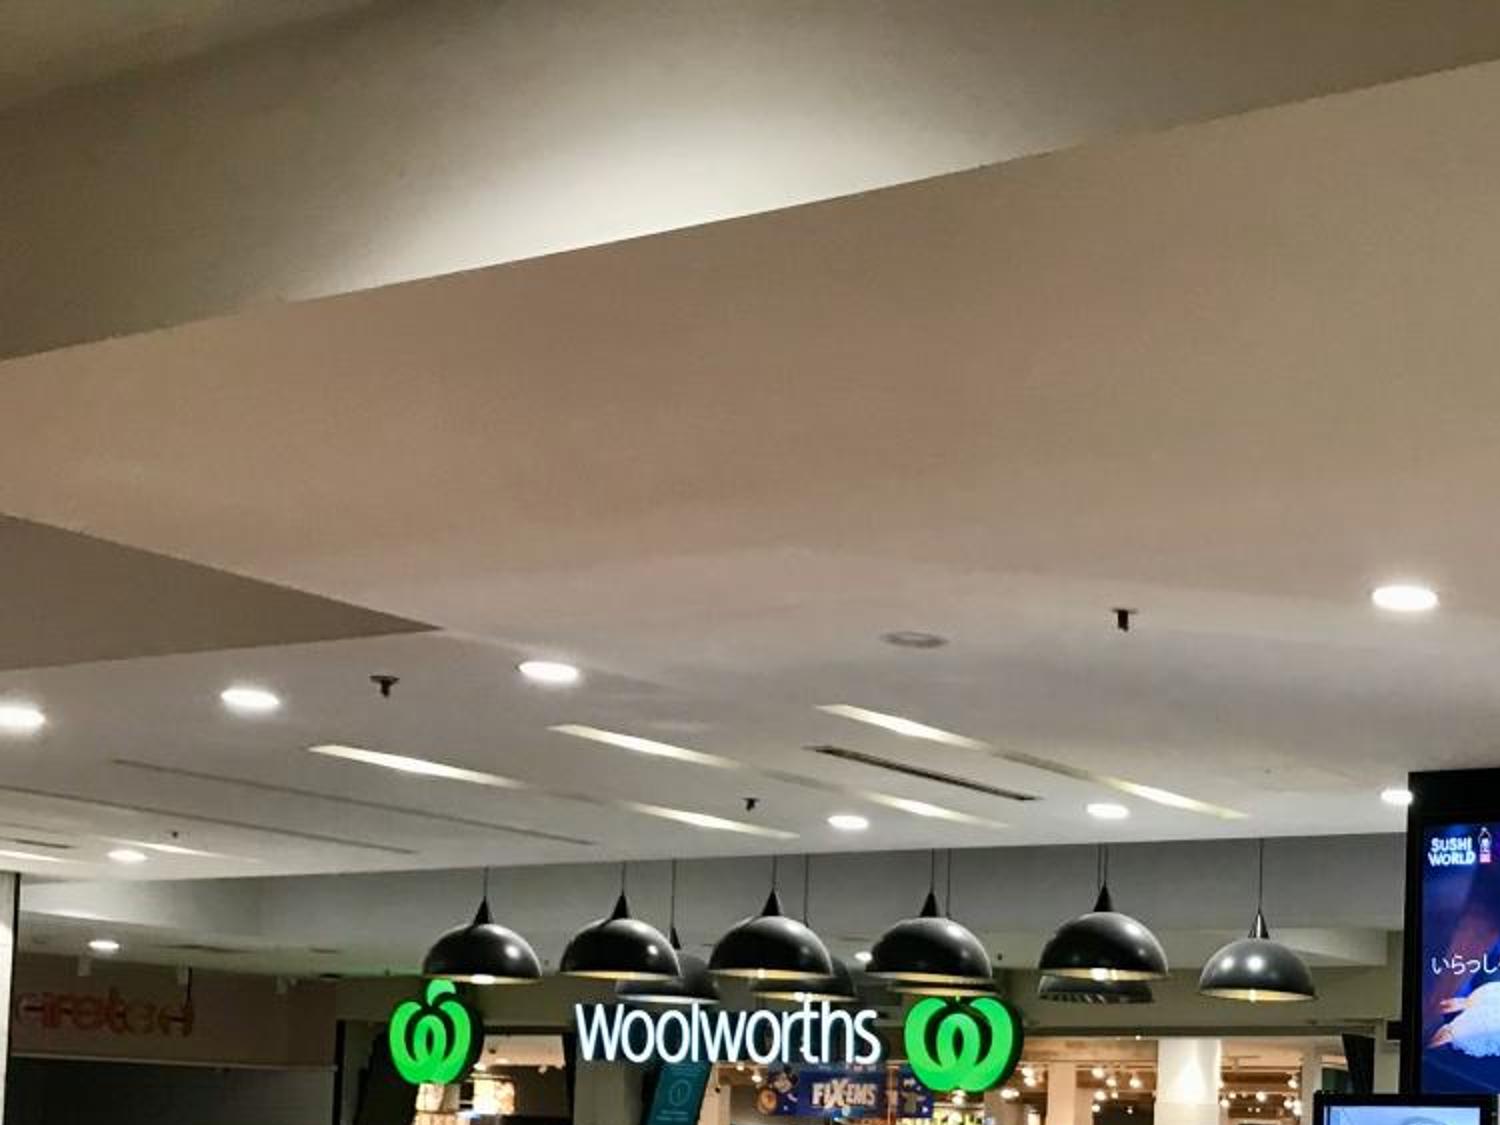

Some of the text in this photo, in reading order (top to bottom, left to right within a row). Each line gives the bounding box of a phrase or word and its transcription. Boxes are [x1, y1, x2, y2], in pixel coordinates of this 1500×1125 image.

[1430, 838, 1472, 851] SUSHI
[1427, 851, 1477, 867] WORLD
[575, 998, 881, 1064] Woolworths
